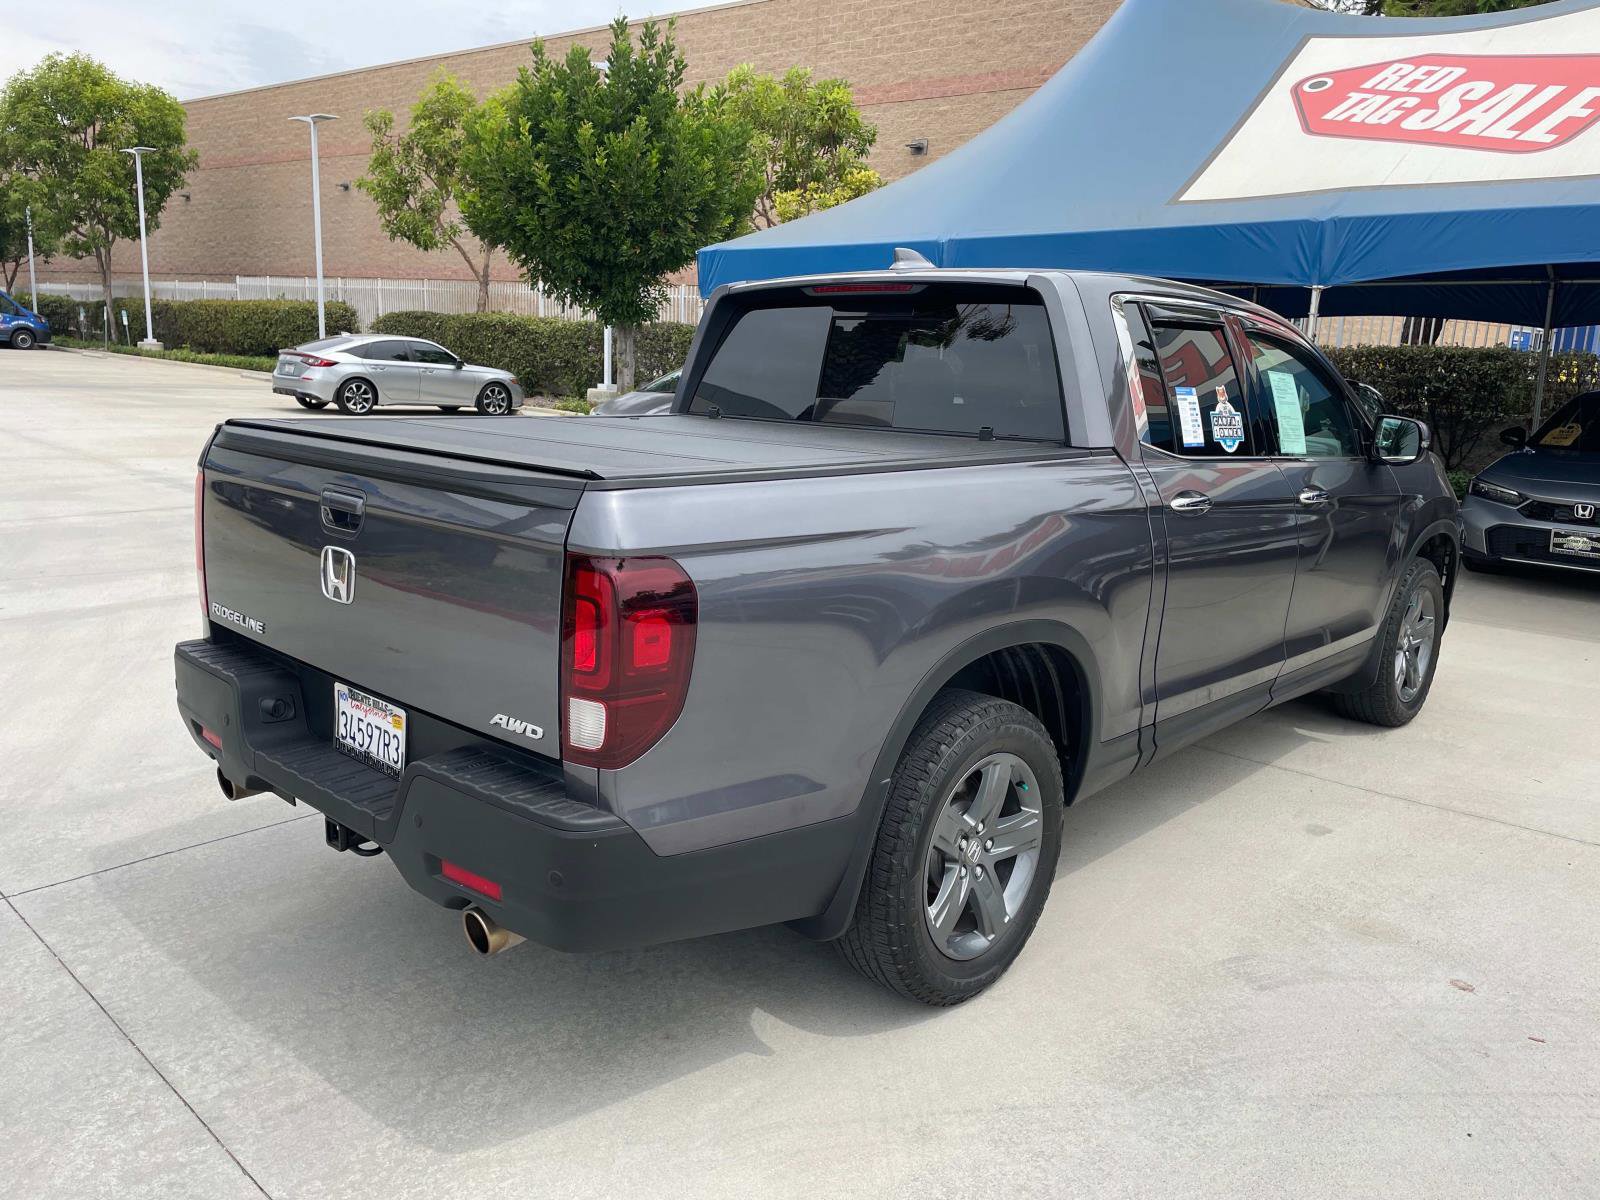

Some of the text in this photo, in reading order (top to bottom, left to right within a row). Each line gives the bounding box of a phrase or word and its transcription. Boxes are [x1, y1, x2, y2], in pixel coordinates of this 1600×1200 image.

[1360, 63, 1467, 94] RED
[1321, 80, 1600, 143] TAG SALE
[212, 602, 266, 634] RIDGELINE
[350, 700, 389, 720] California
[372, 698, 389, 714] HILLS
[340, 710, 400, 765] 34597R3
[489, 713, 544, 740] AWD
